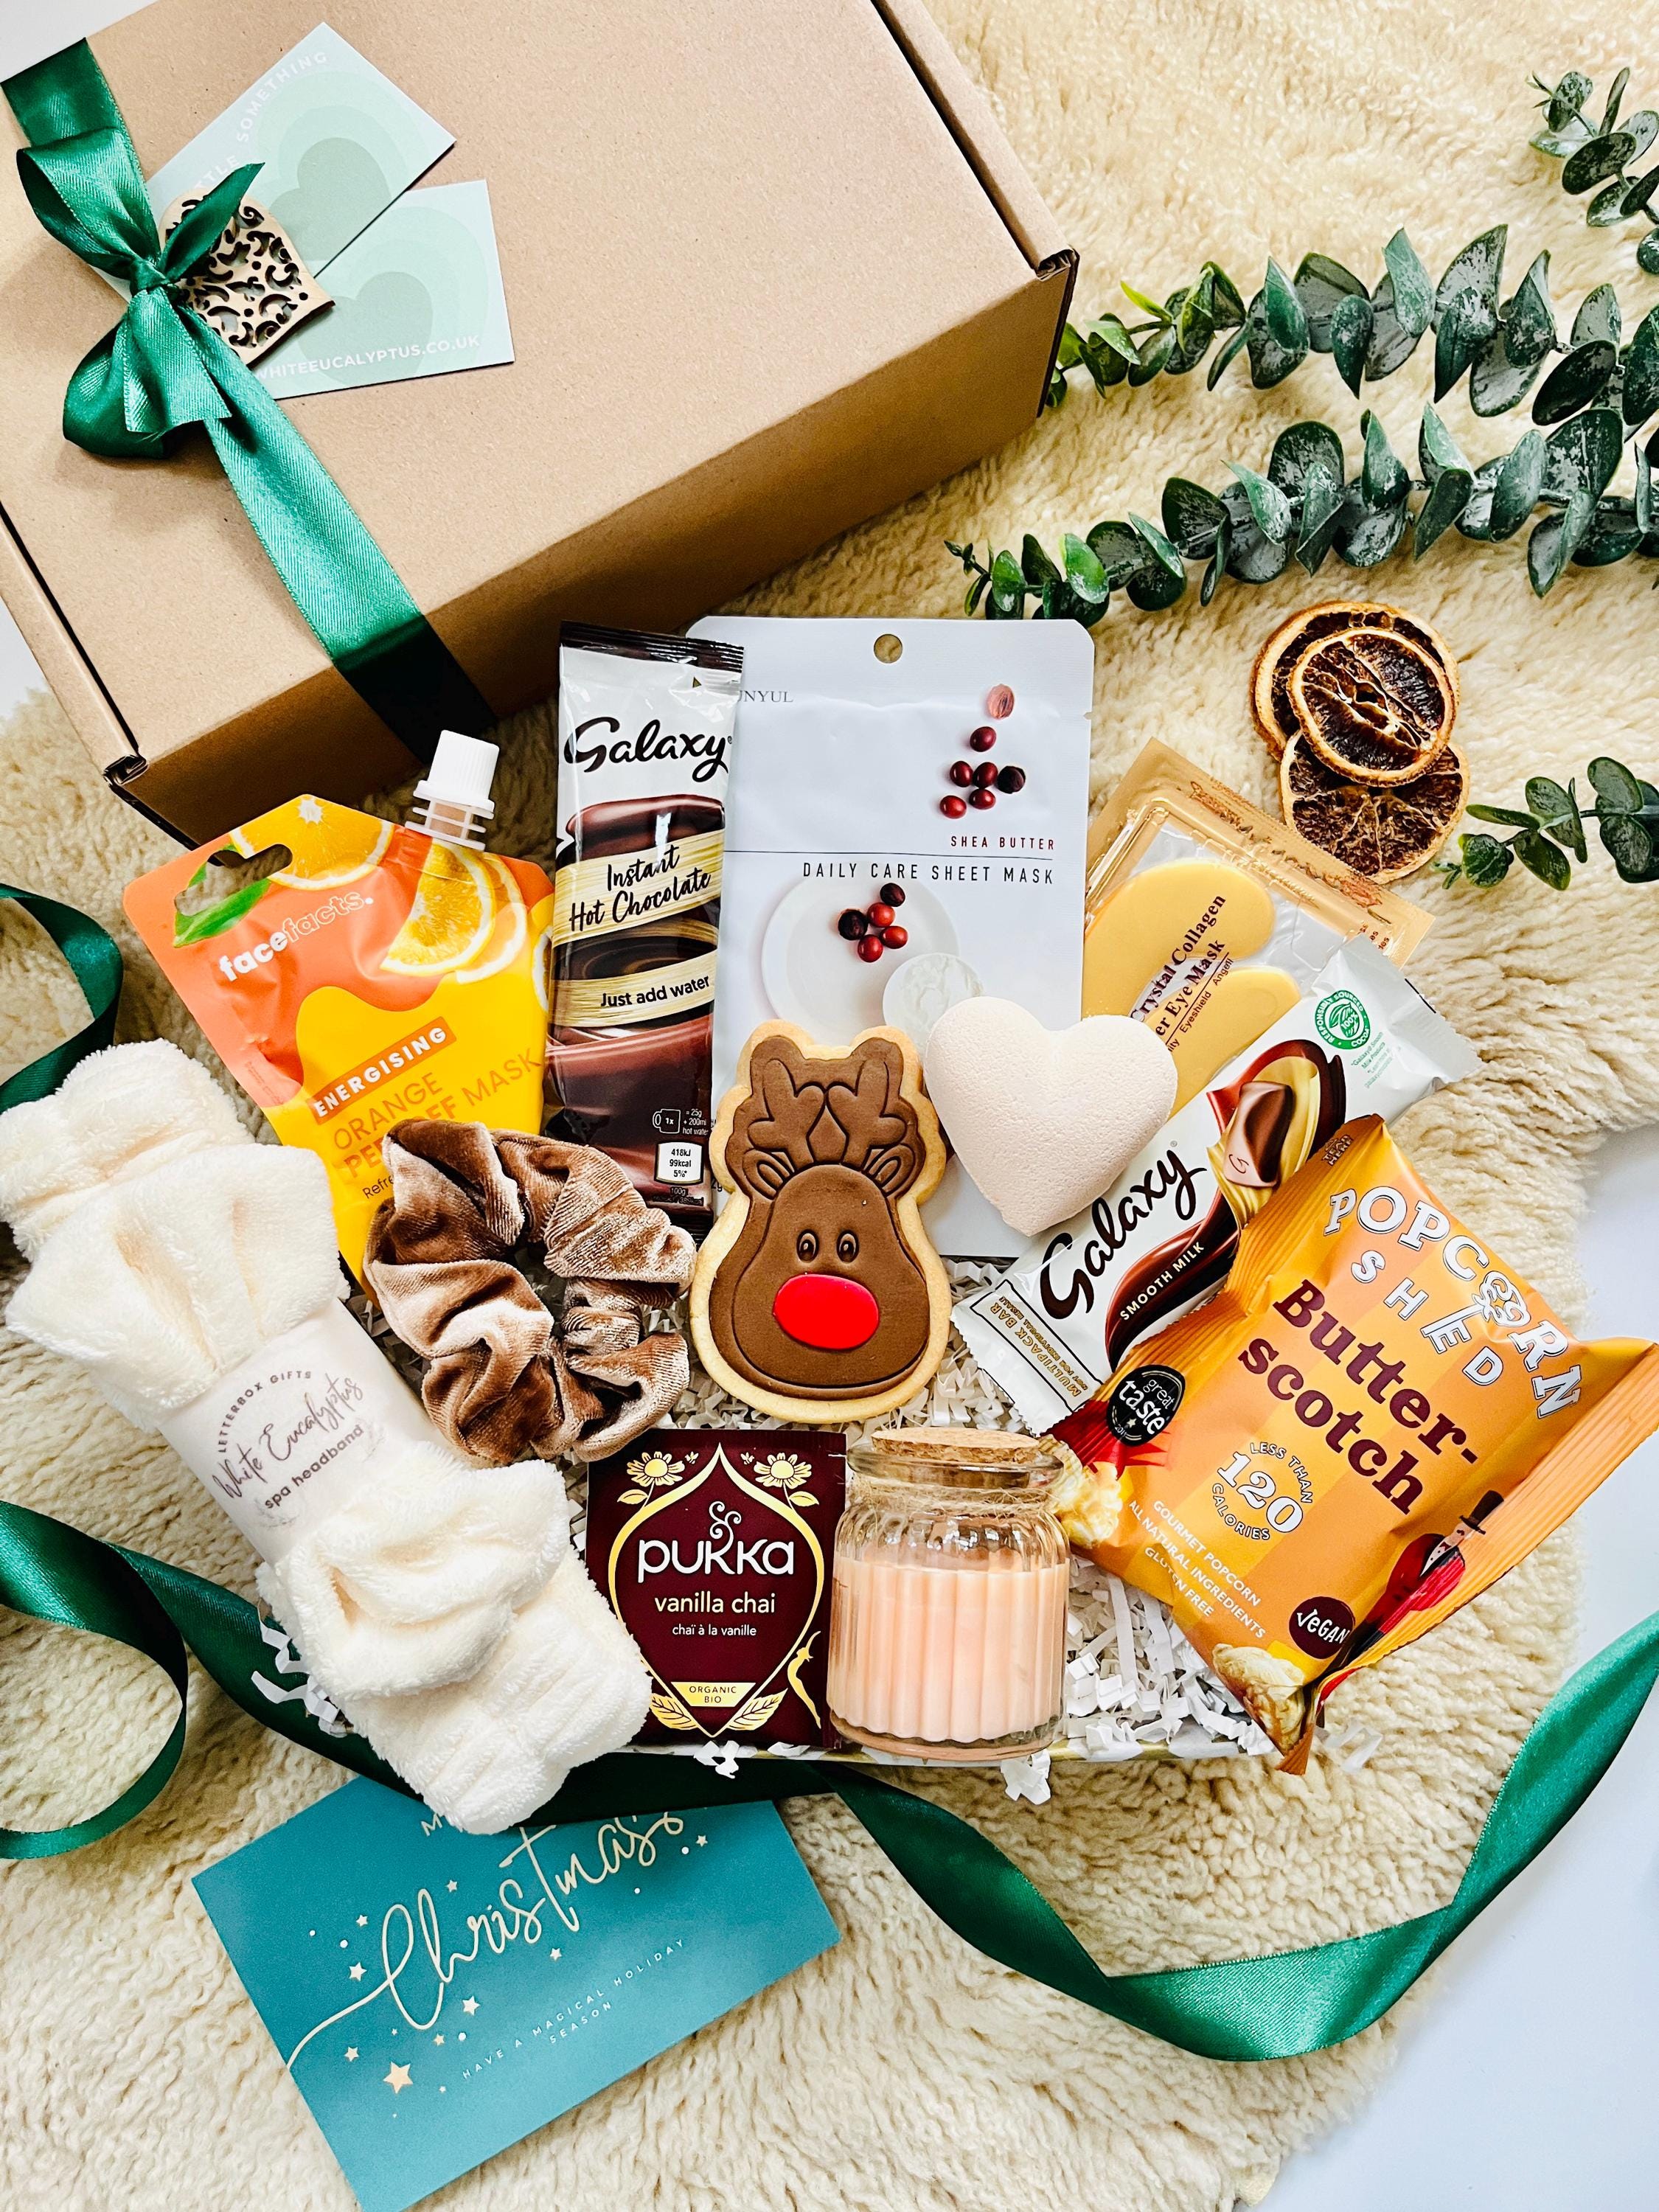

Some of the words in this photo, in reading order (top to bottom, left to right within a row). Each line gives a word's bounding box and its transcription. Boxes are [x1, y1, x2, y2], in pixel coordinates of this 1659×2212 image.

[236, 51, 329, 143] SOMETHING
[193, 155, 240, 189] TTLE
[563, 715, 730, 783] Galaxy
[606, 844, 680, 891] Instant
[802, 863, 858, 878] DAILY
[870, 863, 919, 880] CARE
[931, 866, 991, 883] SHEET
[1004, 866, 1054, 885] MASK
[950, 835, 989, 849] SHEA
[999, 837, 1055, 851] BUTTER
[568, 898, 606, 932] Hot
[611, 866, 712, 923] Chocolate
[1130, 964, 1178, 1023] Crystal
[1171, 895, 1227, 966] Collagen
[1164, 984, 1194, 1018] Eye
[1184, 939, 1226, 986] Mask
[599, 992, 633, 1008] Just
[636, 985, 669, 1004] add
[669, 975, 711, 998] water
[1179, 990, 1212, 1034] Eyeshield
[313, 1026, 448, 1118] ENERGISING
[333, 1071, 445, 1151] ORANGE
[343, 1136, 383, 1179] PE
[461, 1046, 543, 1107] MASK
[665, 1117, 675, 1125] 1x
[683, 1126, 692, 1135] hot
[688, 1117, 707, 1126] 200ml
[691, 1108, 703, 1118] 25g
[669, 1158, 692, 1168] 99kcal
[671, 1148, 692, 1157] 418kJ
[670, 1187, 686, 1197] 100g
[1038, 1146, 1208, 1321] Galaxy
[1119, 1270, 1175, 1321] SMOOTH
[1172, 1242, 1206, 1277] MILK
[1323, 1184, 1582, 1420] POPCORN
[990, 1301, 1018, 1329] BAR
[1350, 1249, 1504, 1388] SHED
[1015, 1326, 1082, 1398] MULTIPACK
[1272, 1278, 1479, 1467] Butter-
[217, 1382, 264, 1454] LETTERBOX
[269, 1370, 313, 1384] GIFTS
[1119, 1380, 1166, 1435] taste
[1142, 1379, 1175, 1410] great
[1237, 1336, 1426, 1516] scotch
[211, 1442, 269, 1500] White
[258, 1372, 364, 1462] Eucalyptus
[264, 1486, 292, 1509] spa
[291, 1423, 365, 1487] headband
[1217, 1450, 1304, 1534] 120
[1249, 1441, 1287, 1460] LESS
[1288, 1455, 1314, 1504] THAN
[1211, 1482, 1270, 1541] CALORIES
[1128, 1499, 1144, 1522] ALL
[1141, 1517, 1193, 1571] NATURAL
[1189, 1565, 1267, 1641] INGREDIENTS
[1144, 1545, 1186, 1593] GLUTEN
[1183, 1587, 1215, 1618] FREE
[1152, 1499, 1207, 1555] GOURMET
[1203, 1550, 1262, 1608] POPCORN
[653, 1590, 725, 1614] vanilla
[731, 1590, 776, 1614] chai
[672, 1624, 696, 1637] chaï
[698, 1624, 706, 1636] à
[707, 1624, 718, 1636] la
[720, 1624, 757, 1637] vanille
[688, 1685, 738, 1694] ORGANIC
[703, 1694, 723, 1704] BIO
[462, 2048, 504, 2081] HAVE
[514, 2039, 523, 2048] A
[532, 1989, 605, 2037] MAGICAL
[613, 1938, 684, 1986] HOLIDAY
[549, 2001, 613, 2045] SEASON
